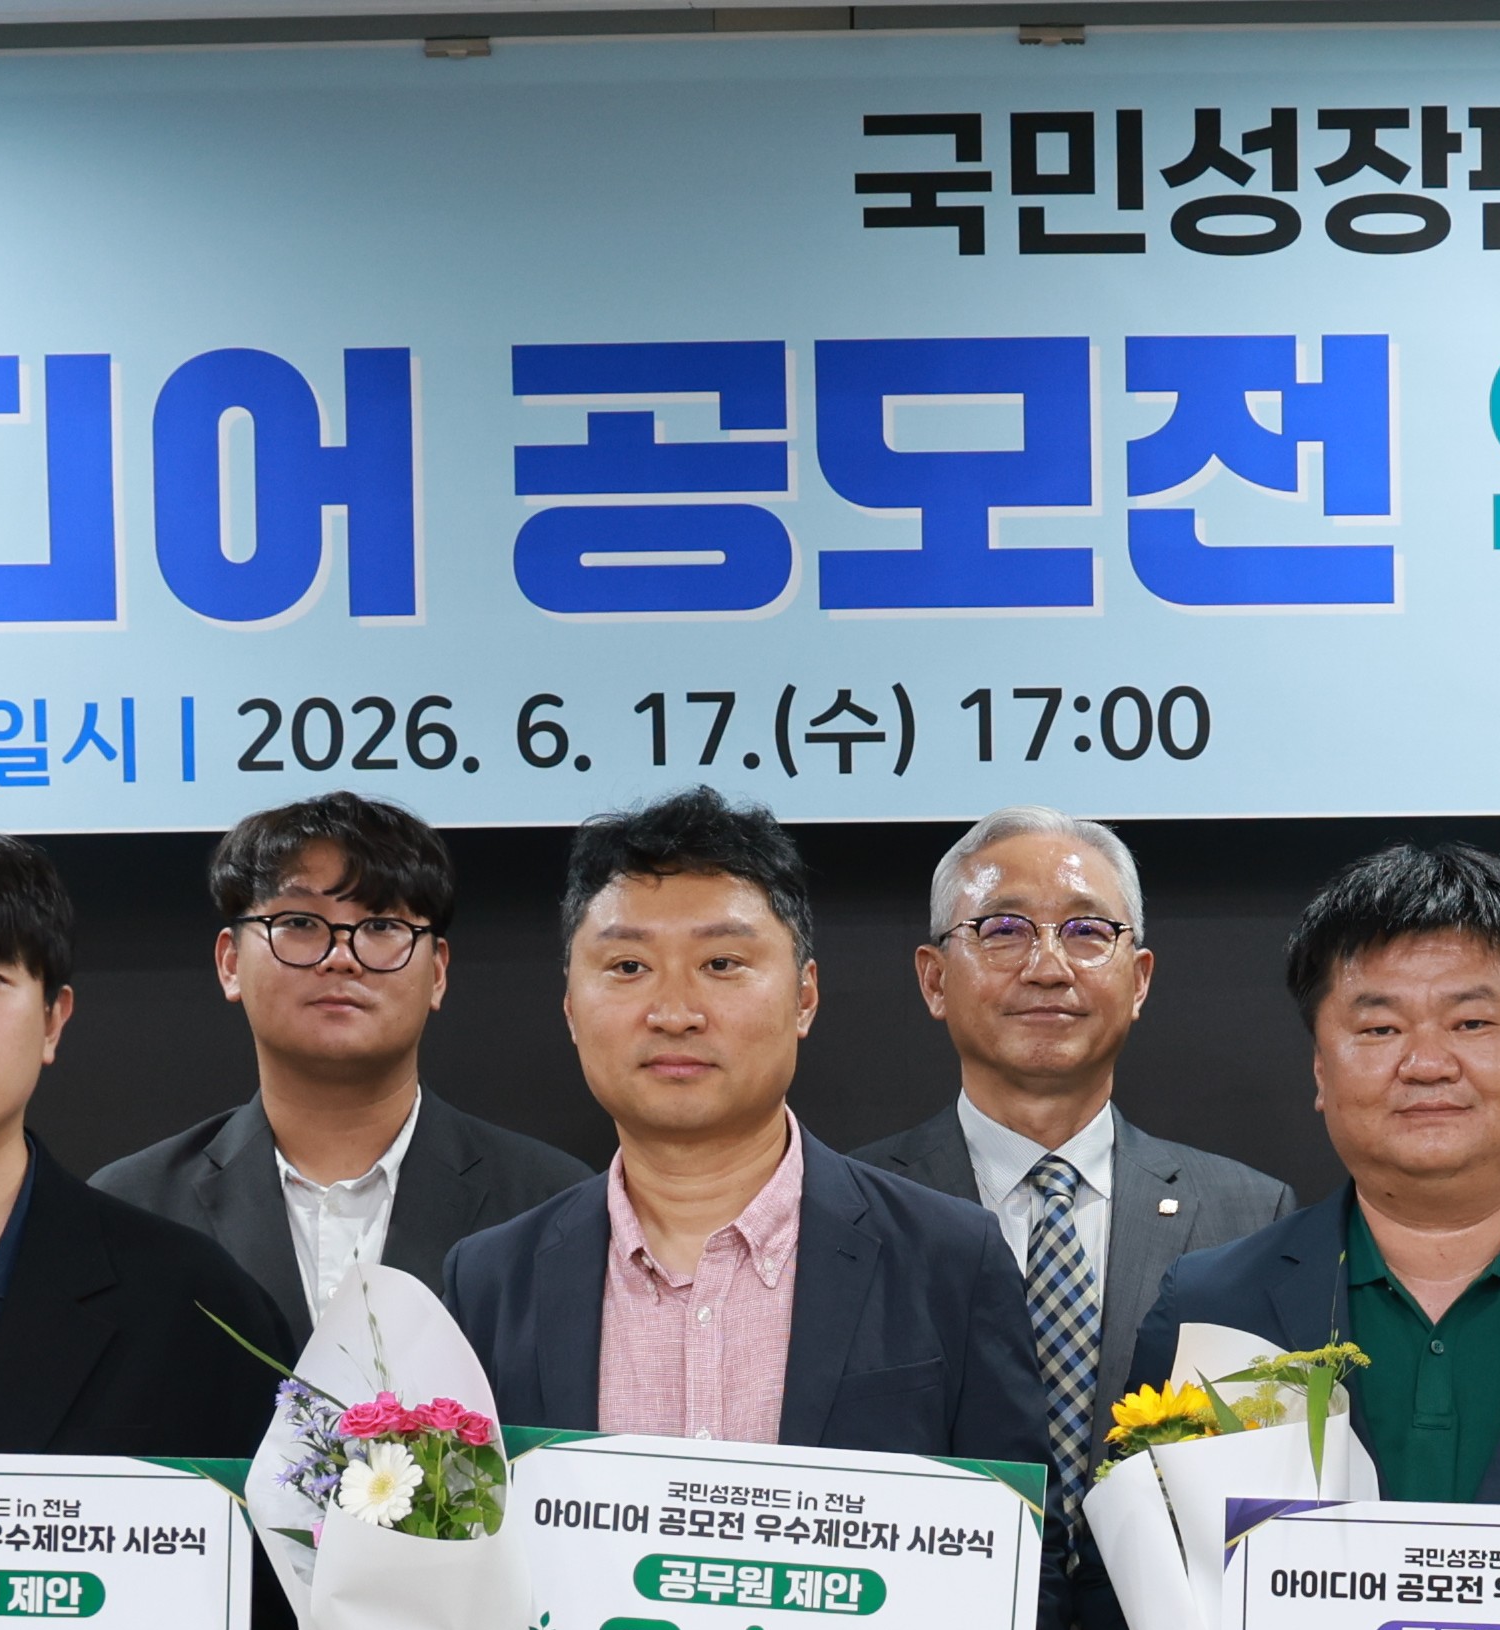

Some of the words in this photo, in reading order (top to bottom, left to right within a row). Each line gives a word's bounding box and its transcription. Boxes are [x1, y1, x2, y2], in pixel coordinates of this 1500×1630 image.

[512, 335, 1393, 613] 공모전
[238, 695, 479, 773] 2026.
[517, 694, 591, 772] 6.
[634, 683, 915, 778] 17.(수)
[961, 686, 1210, 761] 17:00
[17, 1499, 36, 1517] in
[44, 1500, 81, 1518] 전남
[668, 1482, 791, 1508] 국민성장펀드
[798, 1491, 817, 1510] in
[825, 1493, 865, 1514] 전남
[123, 1527, 205, 1555] 시상식
[535, 1498, 649, 1533] 아이디어
[659, 1507, 744, 1540] 공모전
[754, 1515, 899, 1551] 우수제안자
[907, 1526, 993, 1558] 시상식
[8, 1577, 81, 1613] 제안
[660, 1561, 772, 1604] 공무원
[784, 1571, 862, 1611] 제안
[1272, 1570, 1386, 1600] 아이디어
[1397, 1574, 1482, 1604] 공모전
